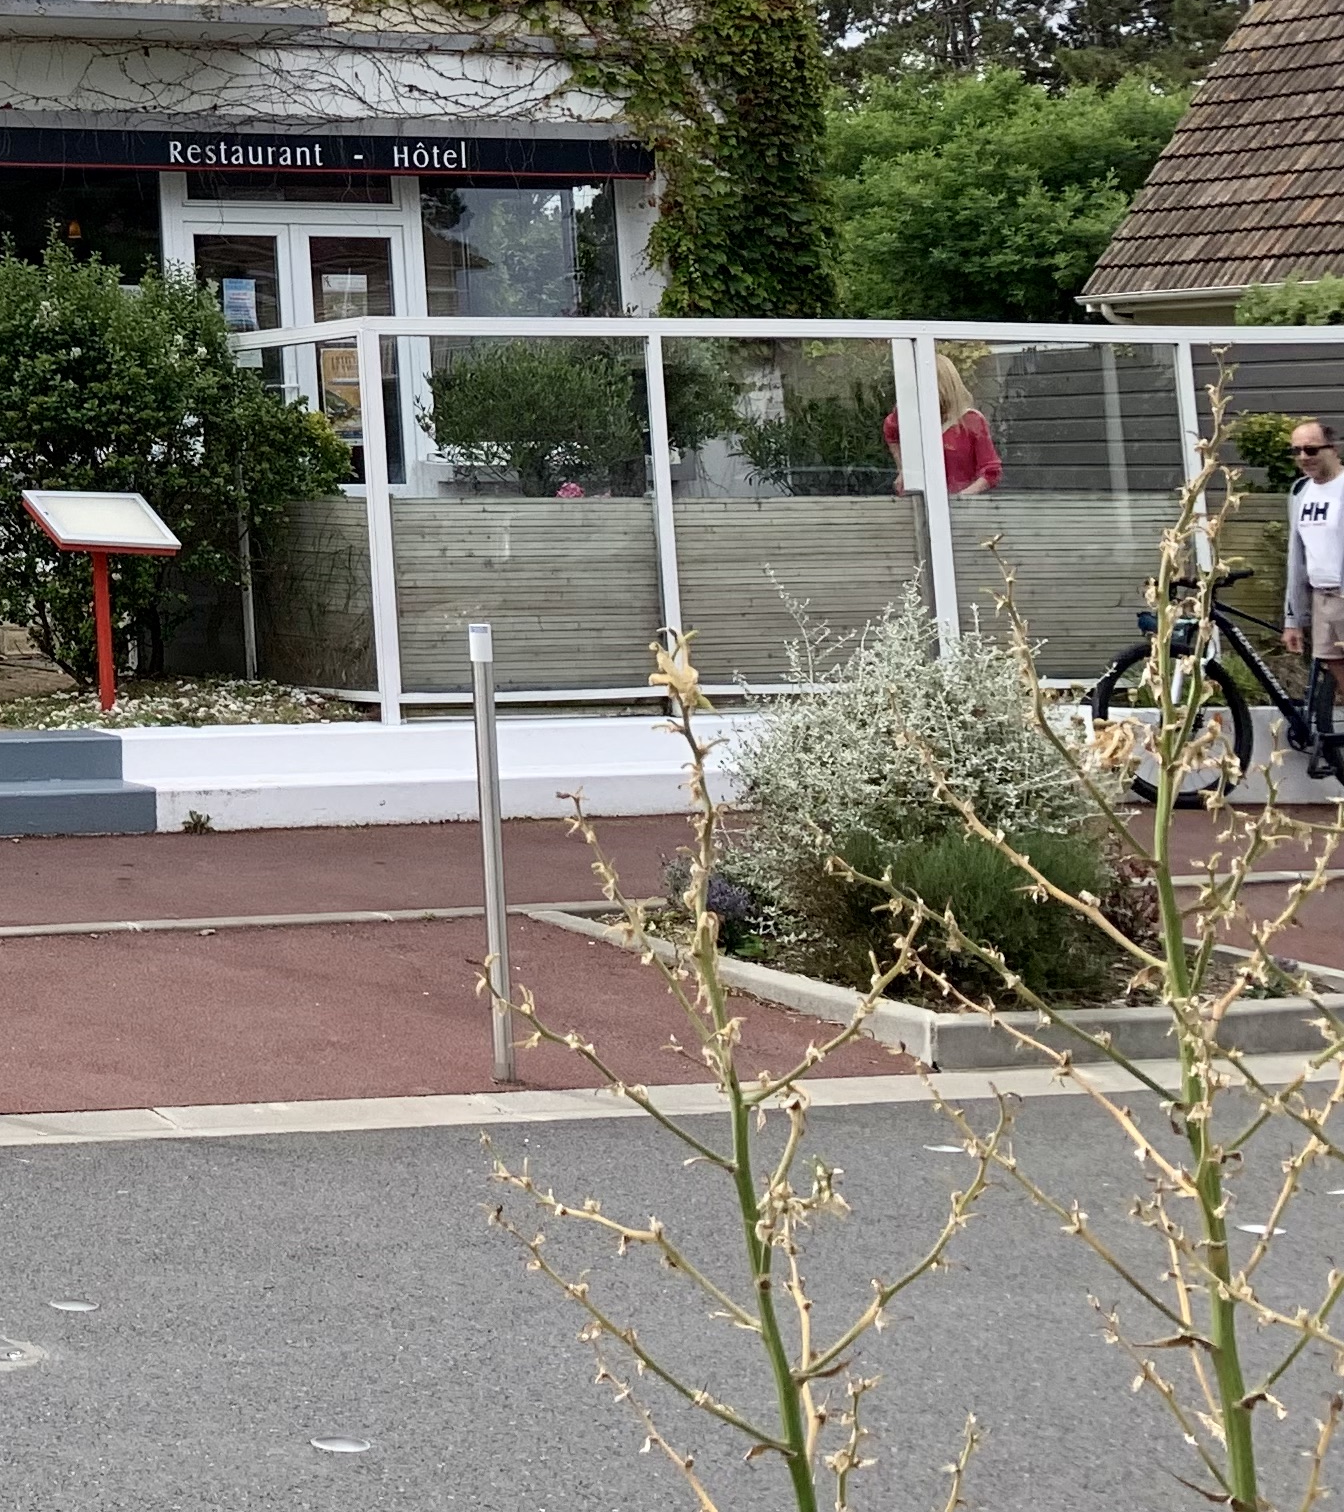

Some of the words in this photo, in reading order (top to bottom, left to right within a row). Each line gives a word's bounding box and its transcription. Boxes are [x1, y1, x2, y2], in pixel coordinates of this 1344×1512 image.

[169, 141, 323, 167] Restaurant
[393, 141, 467, 169] Hôtel
[1301, 502, 1329, 521] HH
